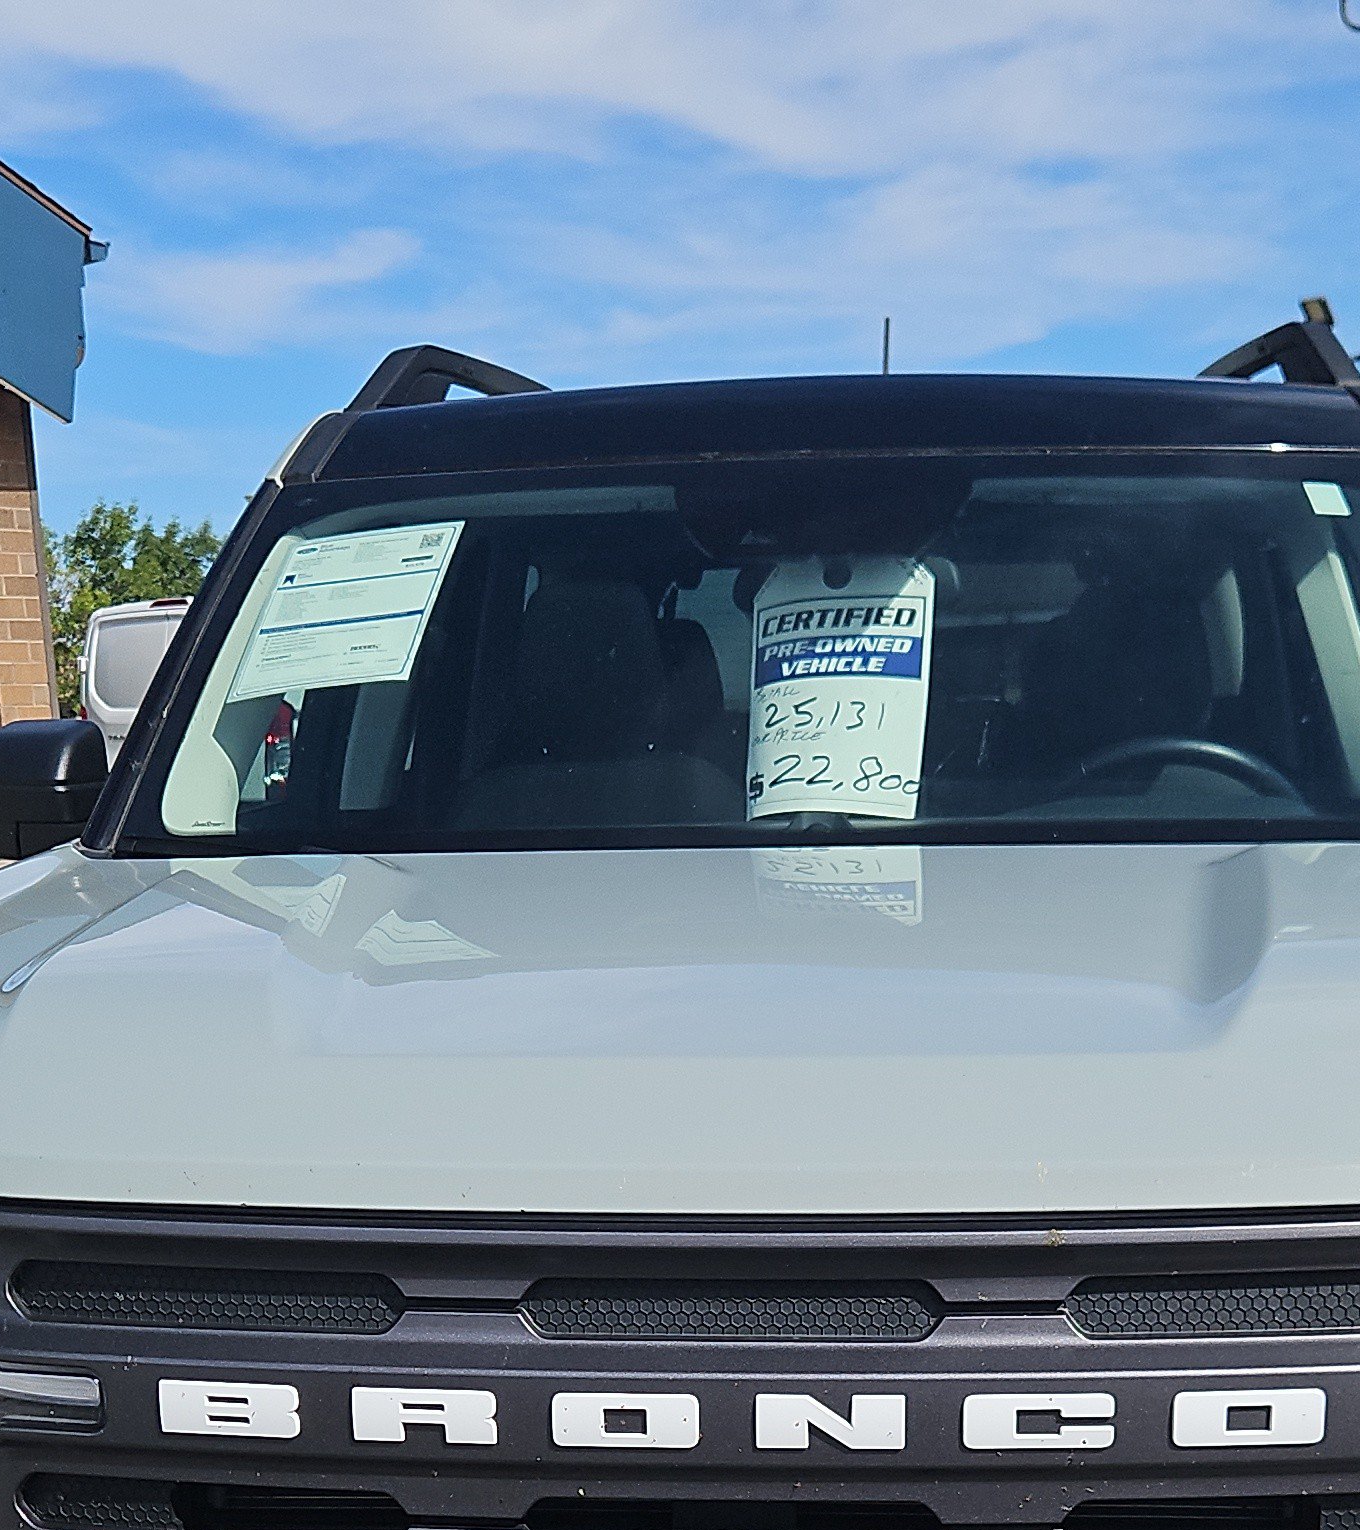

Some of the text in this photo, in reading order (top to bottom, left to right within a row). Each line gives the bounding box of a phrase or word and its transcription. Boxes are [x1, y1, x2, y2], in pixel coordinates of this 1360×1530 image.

[762, 607, 917, 638] CERTIFIED
[764, 638, 913, 661] PRE-OWNED
[781, 657, 887, 676] VEHICLE
[765, 697, 885, 730] 25,131
[157, 1379, 1327, 1451] BRONCO
